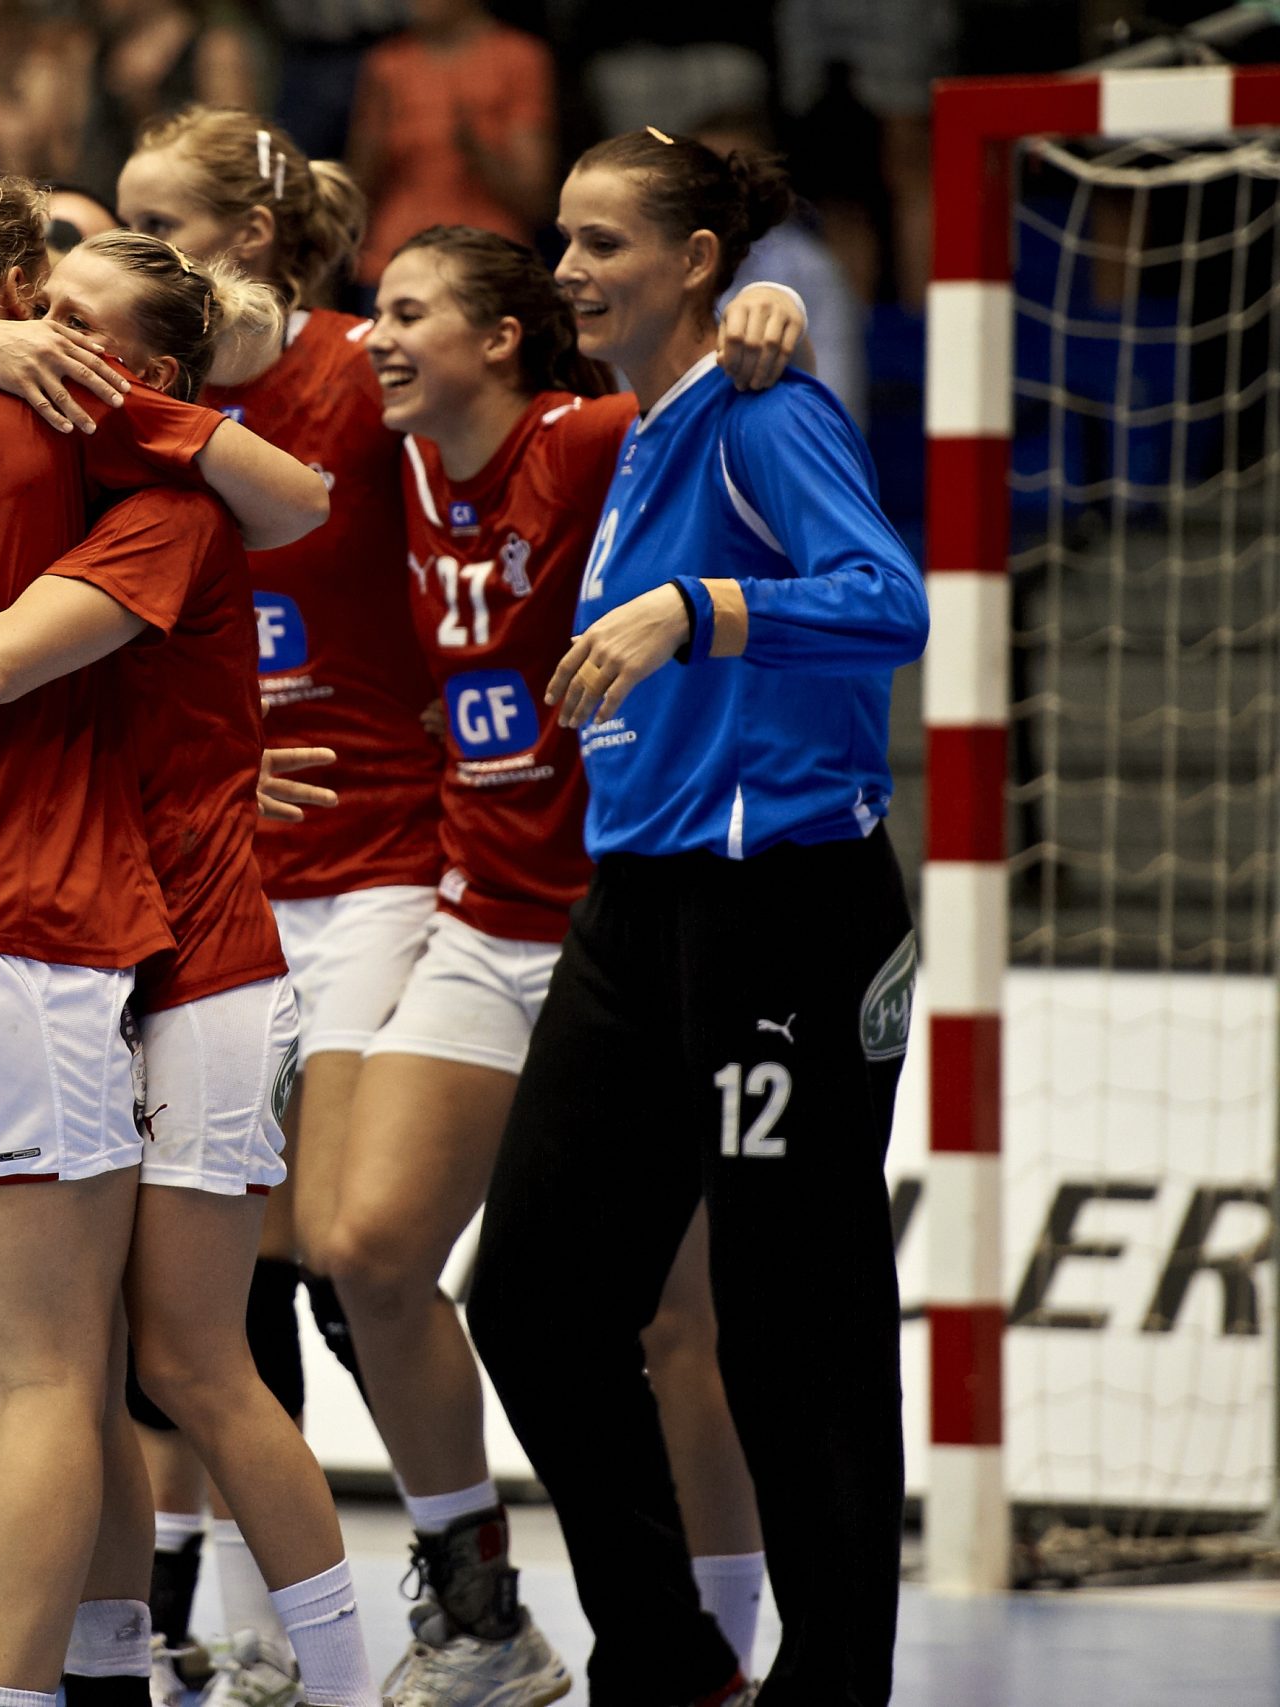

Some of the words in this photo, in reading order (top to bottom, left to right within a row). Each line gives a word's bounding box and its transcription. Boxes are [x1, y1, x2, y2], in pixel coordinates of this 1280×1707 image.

[254, 606, 286, 659] F
[457, 685, 518, 745] GF
[713, 1061, 792, 1158] 12
